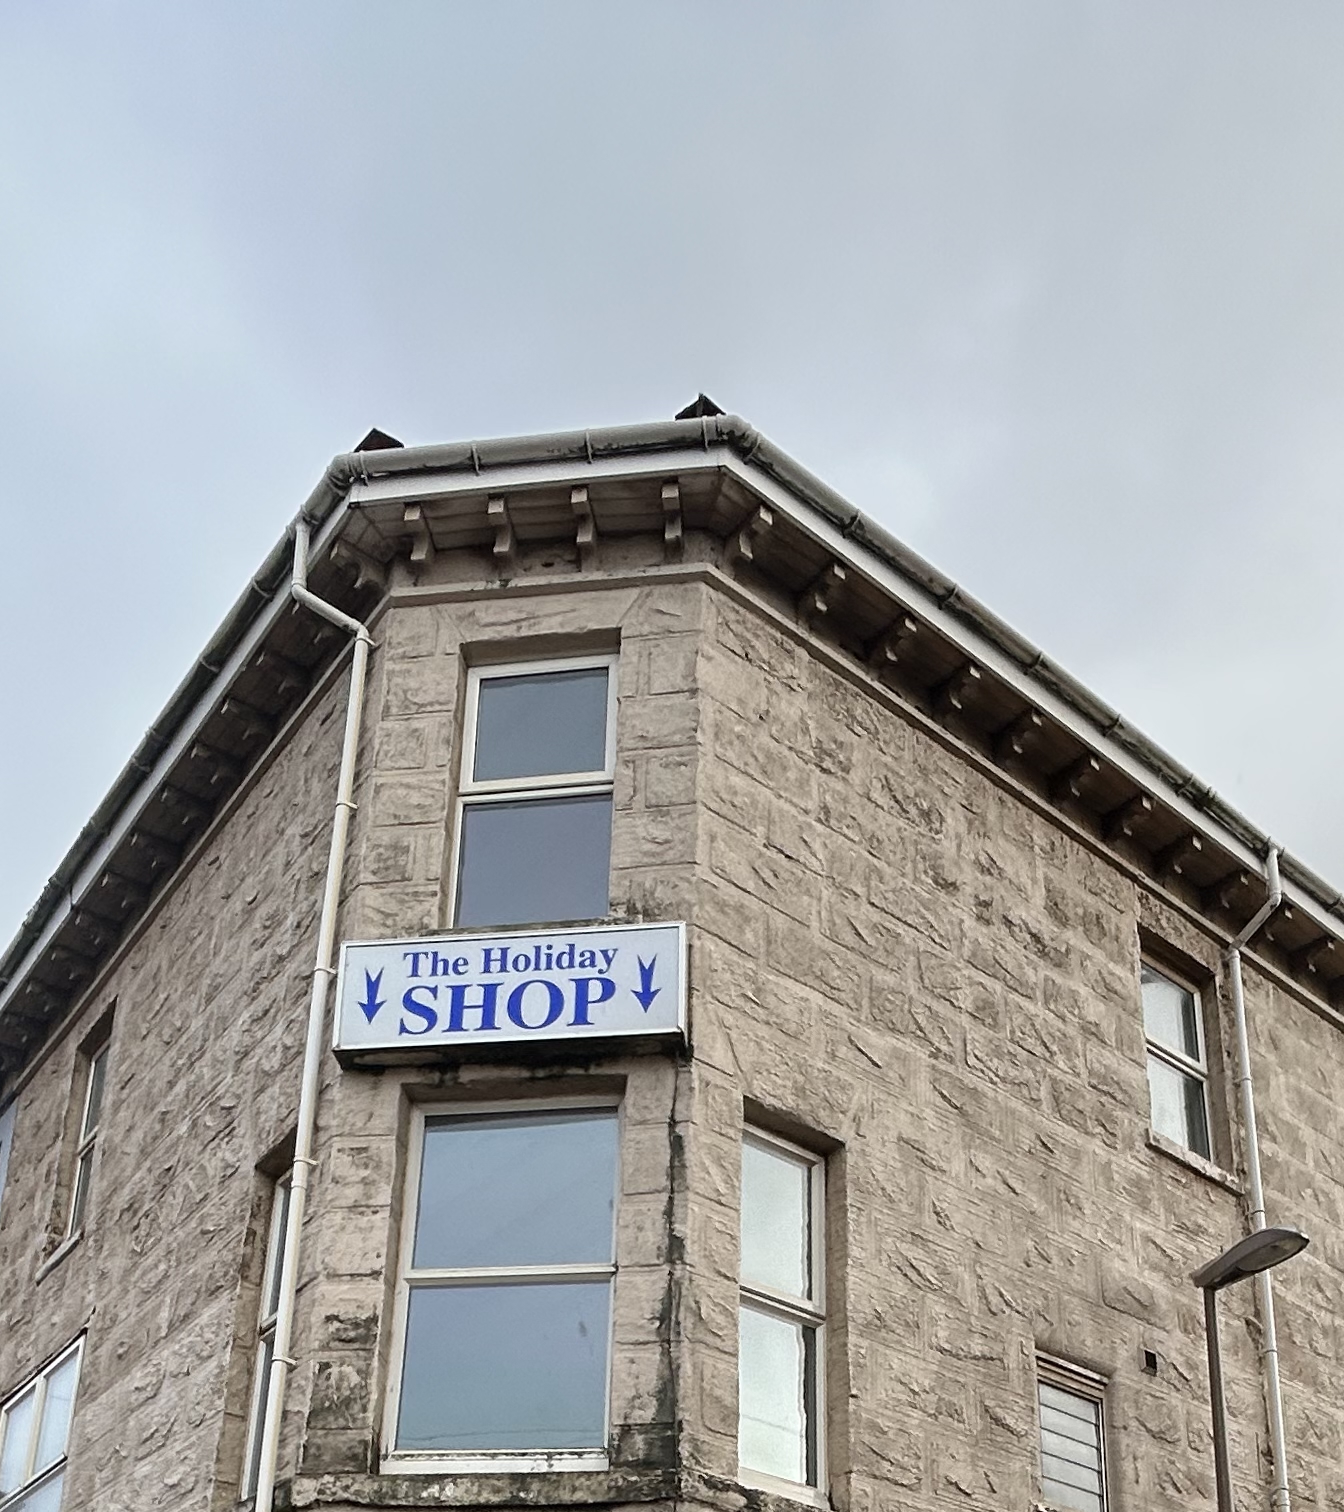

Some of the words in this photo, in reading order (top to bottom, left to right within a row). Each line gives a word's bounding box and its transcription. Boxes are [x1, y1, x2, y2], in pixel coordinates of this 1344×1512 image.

[403, 951, 469, 978] The
[480, 944, 618, 975] Holiday
[398, 977, 616, 1036] SHOP
